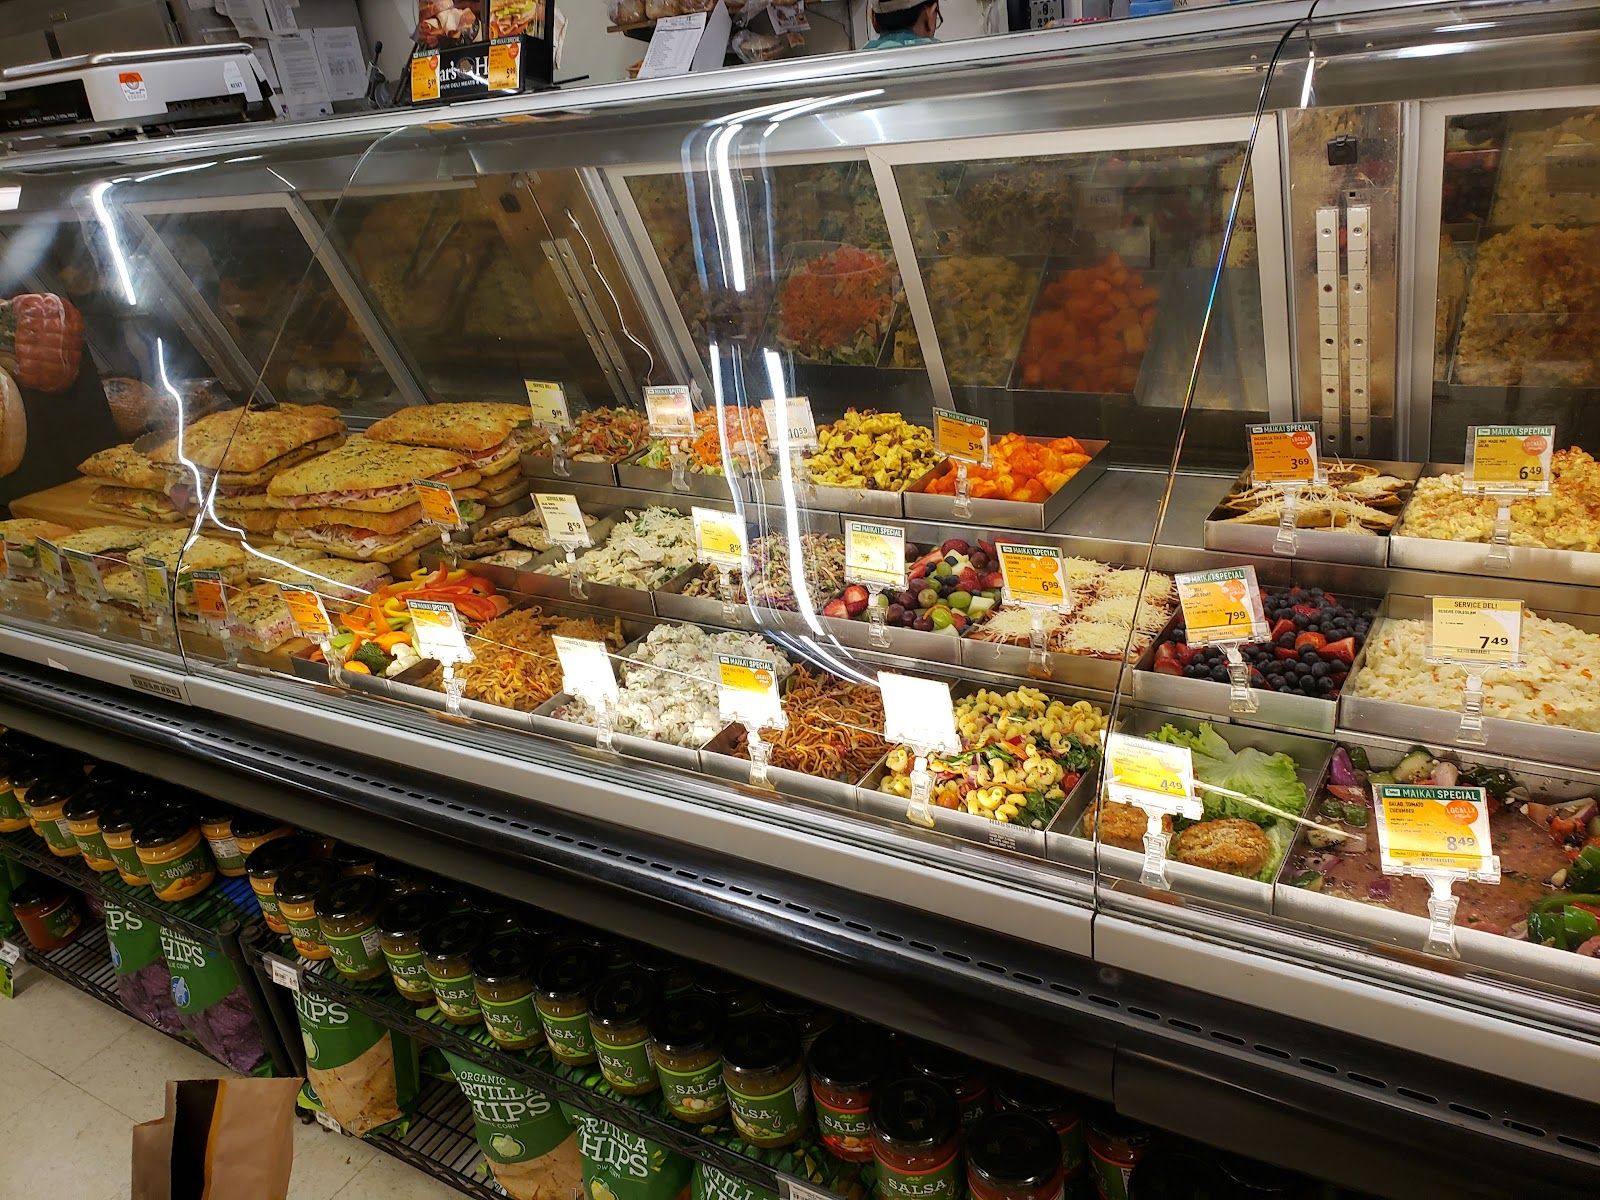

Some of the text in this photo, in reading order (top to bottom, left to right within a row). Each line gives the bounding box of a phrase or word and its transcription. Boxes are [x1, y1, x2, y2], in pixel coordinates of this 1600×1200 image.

[1519, 427, 1550, 436] SPECIAL
[880, 526, 902, 537] SPECIAL
[1032, 548, 1057, 557] SPECIAL
[1215, 571, 1244, 580] SPECIAL
[1453, 601, 1482, 609] SERVICE
[749, 660, 772, 671] SPECIAL
[1437, 789, 1478, 800] SPECIAL
[160, 936, 206, 968] HIPS
[460, 1070, 507, 1086] ORGANIC
[472, 1094, 552, 1123] HIPS
[576, 1116, 648, 1155] RTILLA
[888, 1178, 948, 1197] SALSA
